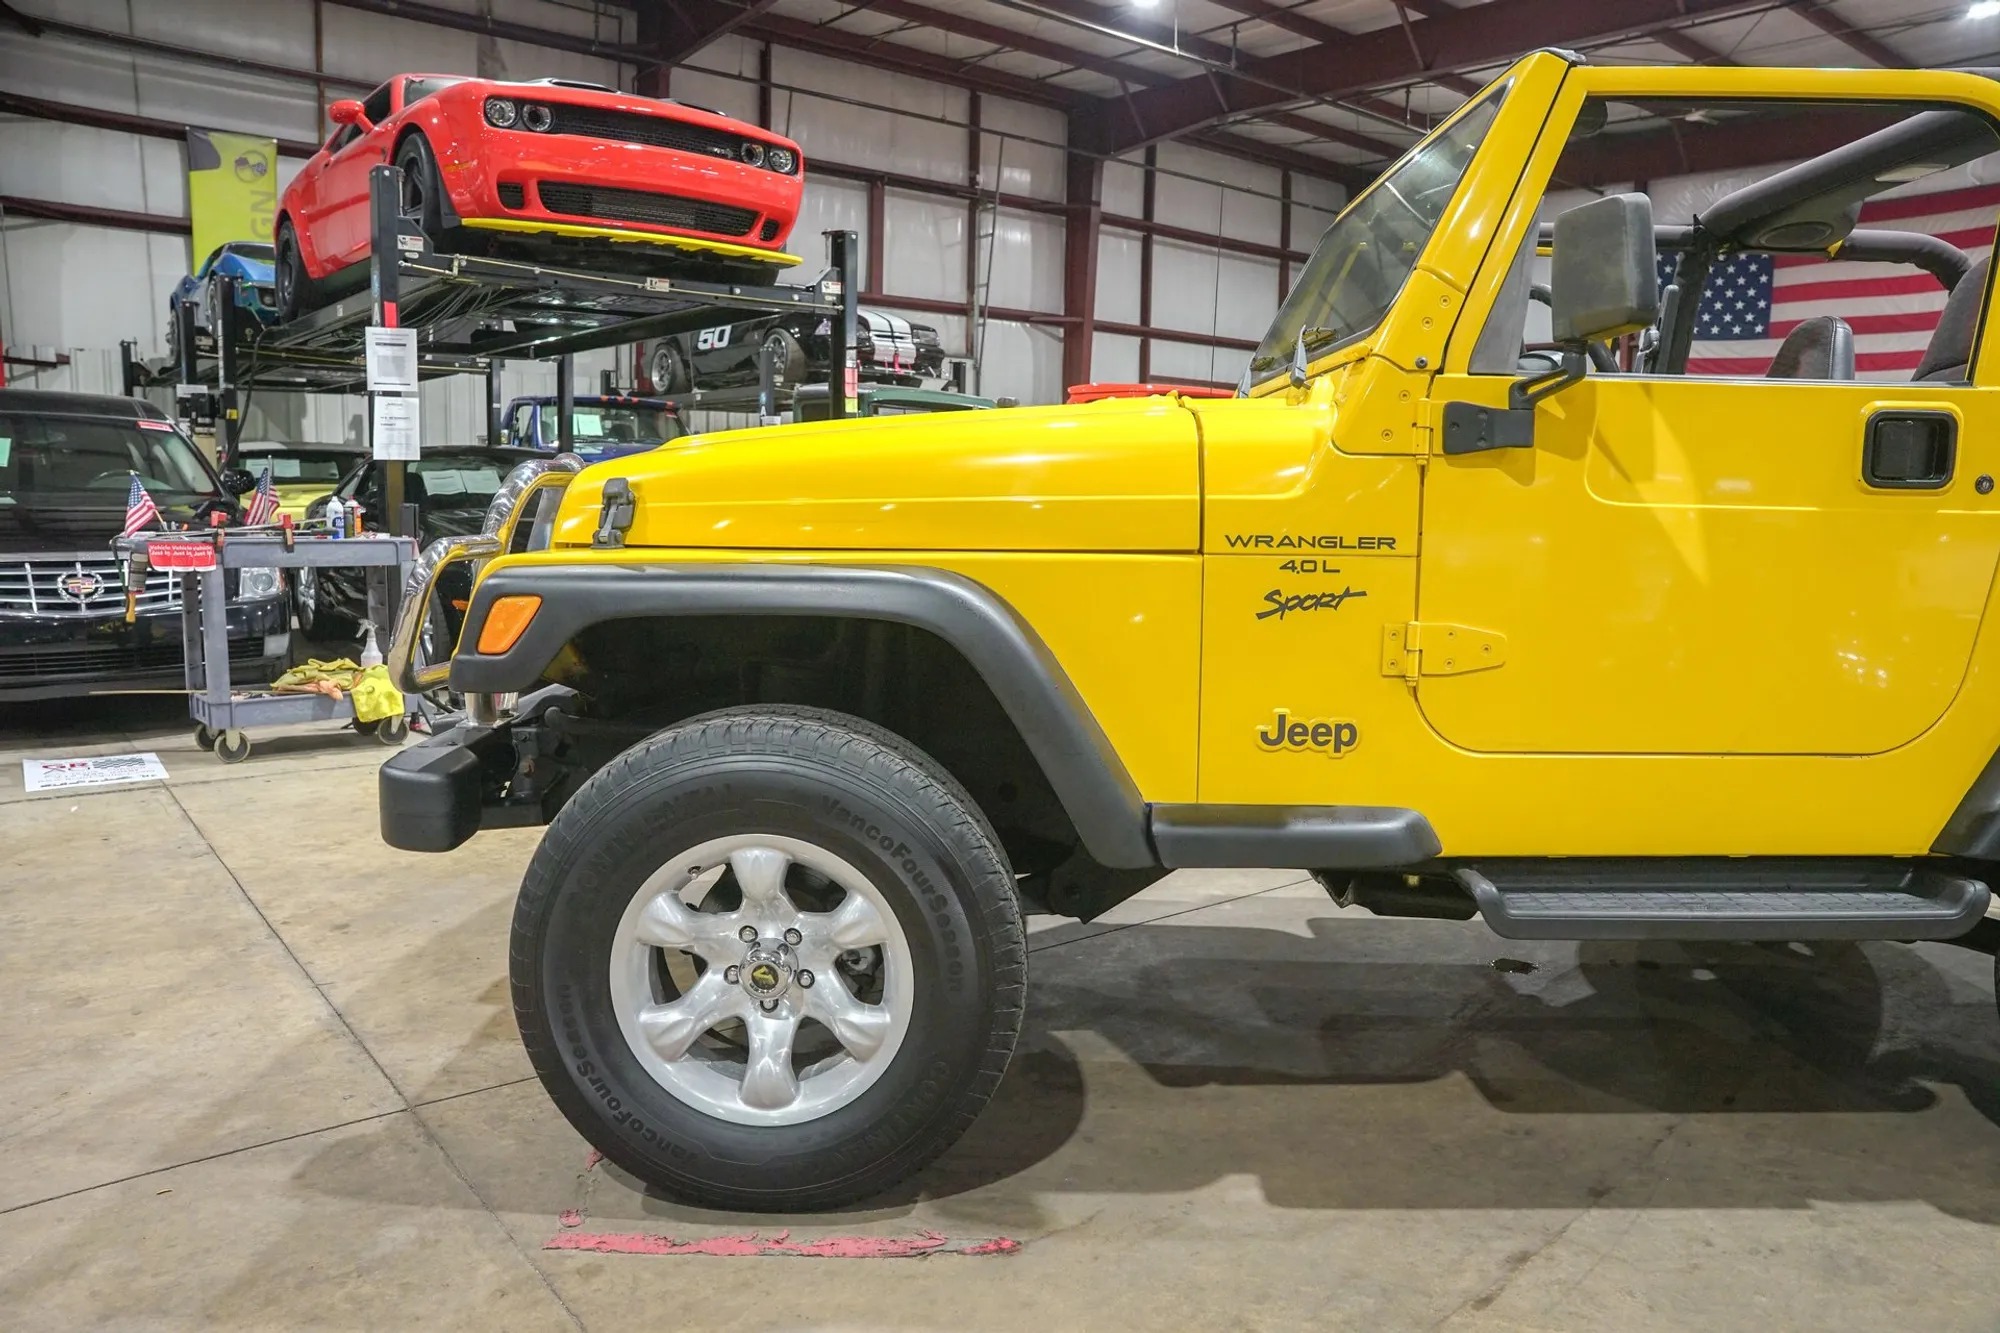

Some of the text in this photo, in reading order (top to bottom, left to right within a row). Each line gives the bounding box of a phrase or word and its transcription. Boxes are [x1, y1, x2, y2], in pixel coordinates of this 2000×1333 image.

[1225, 534, 1397, 551] WRANGLER
[1260, 713, 1357, 754] Jeep
[821, 793, 964, 992] VancoFourSeason
